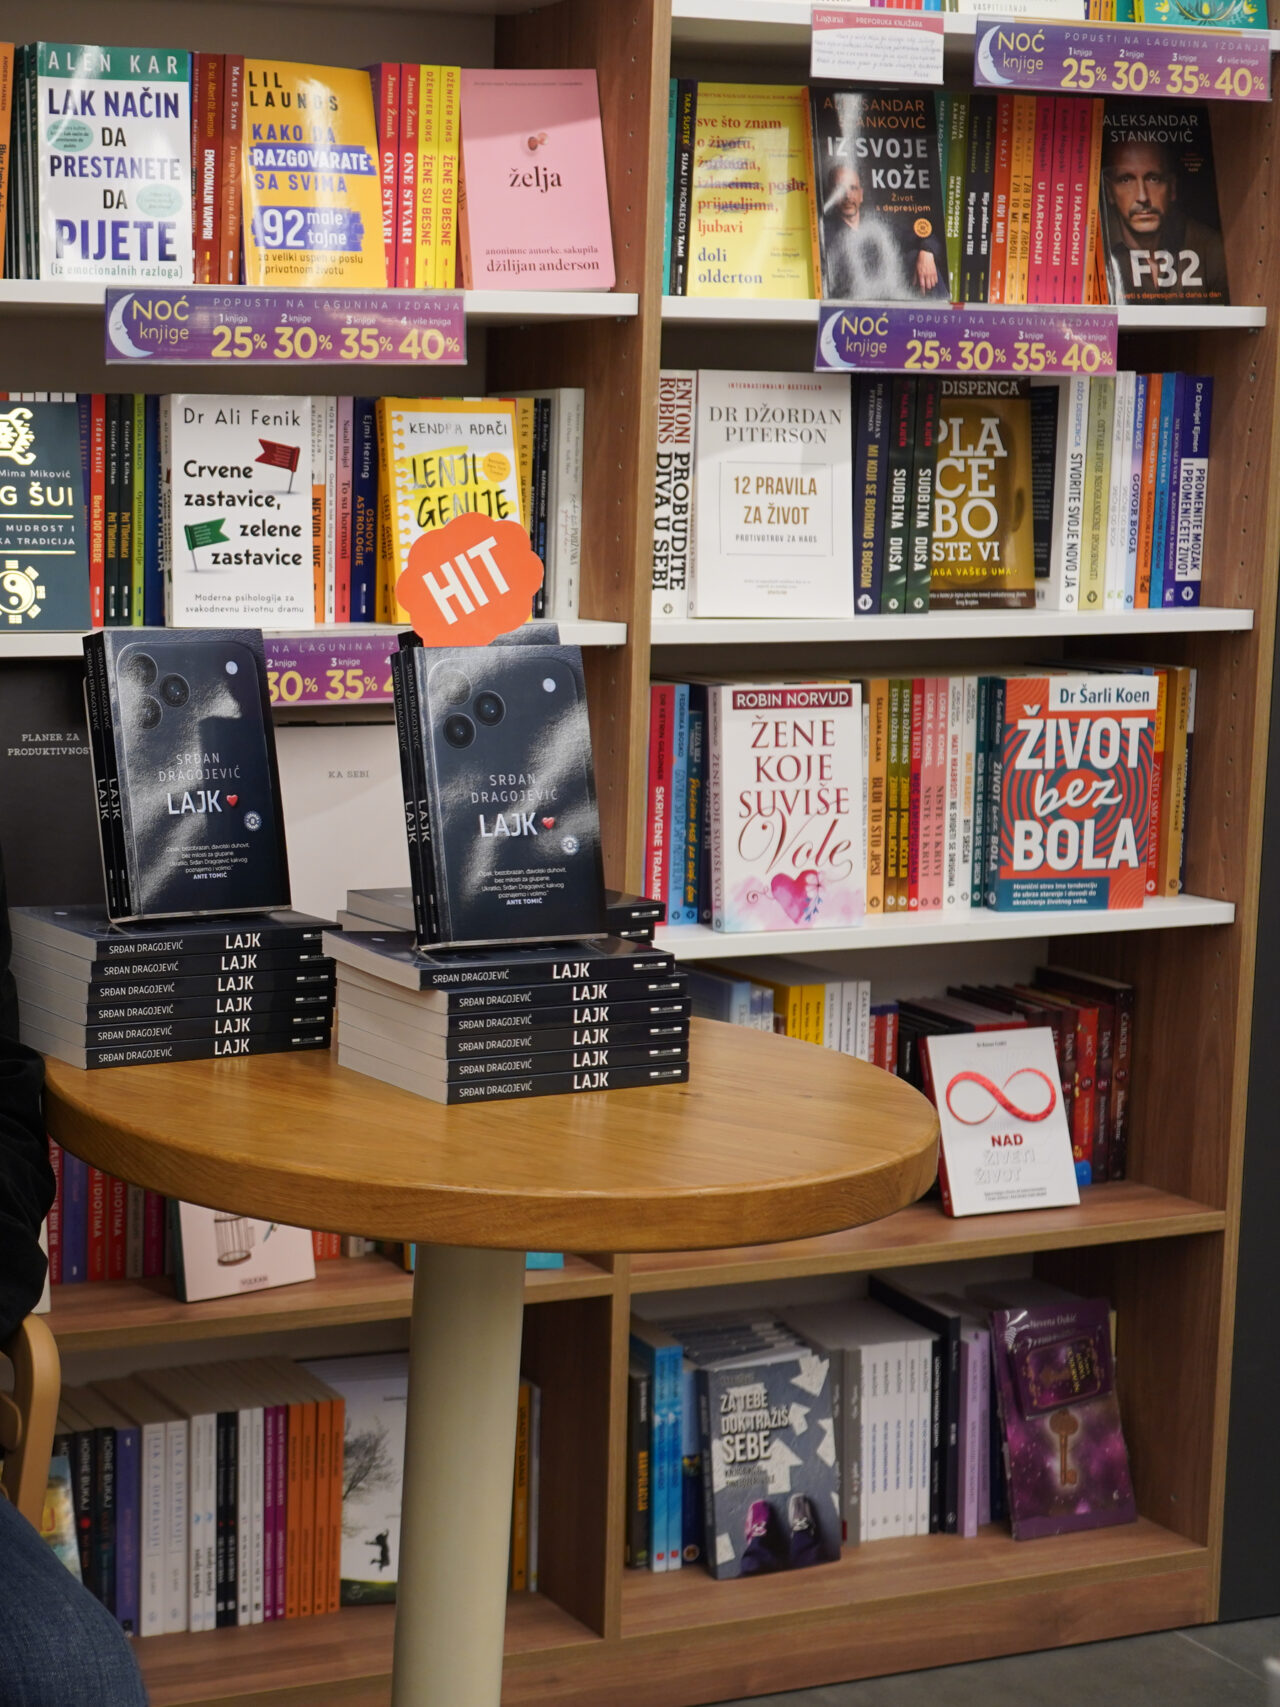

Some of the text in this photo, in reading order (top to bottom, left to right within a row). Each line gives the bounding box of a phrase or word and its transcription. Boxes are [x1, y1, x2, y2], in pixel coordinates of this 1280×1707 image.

[998, 29, 1046, 52] NOĆ
[48, 50, 177, 74] ALEN KAR
[1003, 52, 1044, 74] knjige
[249, 71, 282, 88] LIL
[1060, 59, 1264, 97] 25% 30% 35% 40%
[48, 86, 180, 119] LAK NAČIN
[696, 115, 782, 129] sve što znam
[1102, 114, 1198, 127] ALEKSANDAR
[102, 127, 126, 147] DA
[252, 124, 336, 143] KAKO DA
[1110, 128, 1194, 143] STANKOVIĆ
[827, 136, 928, 158] IZ SVOJE
[50, 155, 181, 181] PRESTANETE
[253, 148, 369, 171] RAZGOVARATE
[255, 174, 347, 193] SA SVIMA
[509, 166, 562, 193] želja
[871, 164, 930, 189] KOŽE
[103, 189, 127, 210] DA
[401, 152, 414, 244] ONE STVARI
[263, 209, 305, 246] 92
[307, 210, 344, 225] male
[697, 219, 744, 236] ljubavi
[55, 219, 177, 262] PIJETE
[307, 229, 347, 247] tajne
[698, 247, 727, 262] doli
[486, 257, 599, 275] džilijan anderson
[698, 269, 763, 284] olderton
[1129, 250, 1203, 288] F32
[132, 296, 190, 321] NOĆ
[213, 298, 461, 312] POPUSTI NA LAGUNINA IZDANJA
[139, 323, 189, 344] knjige
[211, 326, 460, 360] 25% 30% 35% 40%
[942, 380, 1020, 395] DISPENCA
[184, 408, 301, 427] Dr Ali Fenik
[709, 403, 842, 424] DR DŽORDAN
[409, 420, 507, 435] KENDA ADAČI
[725, 427, 828, 443] PITERSON
[361, 415, 373, 479] Ejmi Hering
[30, 469, 71, 478] Miković
[184, 460, 253, 478] Crvene
[412, 453, 478, 488] LENJI
[935, 458, 996, 498] CE
[29, 481, 73, 506] ŠUI
[652, 377, 675, 591] ROBINS DIVA U SEBI
[670, 378, 693, 590] ENTONI PROBUDITE
[733, 476, 817, 495] 12 PRAVILA
[184, 490, 281, 510] zastavice,
[417, 489, 509, 528] GENIJE
[744, 503, 810, 525] ZA ŽIVOT
[889, 469, 907, 572] SUDBINA DUŠA
[932, 498, 998, 538] BO
[6, 524, 64, 532] MUDROST
[240, 519, 302, 537] zelene
[355, 495, 364, 566] ASTROLOGIJE
[365, 508, 374, 552] OSNOVE
[736, 534, 784, 542] PROTIVOTROV
[799, 535, 817, 543] HAOS
[17, 537, 75, 545] TRADICIJA
[932, 542, 1000, 561] STE VI
[211, 548, 303, 565] zastavice
[422, 536, 510, 625] HIT
[185, 605, 304, 613] svakodnevnu životnu dramu
[195, 594, 232, 602] Moderna
[235, 594, 282, 604] psihologija
[736, 691, 849, 708] ROBIN NORVUD
[1060, 683, 1150, 704] Dr Šarli Koen
[751, 715, 836, 749] ŽENE
[1015, 704, 1149, 770] ŽIVOT
[8, 747, 91, 756] PRODUKTIVNOS
[176, 752, 220, 765] SRĐAN
[159, 765, 241, 783] DRAGOJEVIĆ
[489, 774, 536, 786] SRĐAN
[755, 754, 833, 784] KOJE
[167, 790, 223, 815] LAJK
[471, 789, 558, 804] DRAGOJEVIĆ
[739, 783, 849, 818] SUVIŠE
[1034, 774, 1123, 817] bez
[479, 812, 538, 838] LAJK
[738, 807, 853, 882] Vole
[1013, 818, 1140, 871] BOLA
[109, 933, 261, 955] SRĐAN DRAGOJEVIĆ LAJK
[432, 962, 590, 984] SRĐAN DRAGOJEVIĆ LAJK
[98, 1039, 250, 1063] SRĐAN DRAGOJEVIĆ LAJK
[991, 1133, 1023, 1147] NAD
[93, 1182, 103, 1239] IDIOTIMA
[720, 1390, 768, 1413] ZA TEBE
[721, 1404, 790, 1434] DOK TRAŽIŠ
[722, 1431, 771, 1464] SEBE
